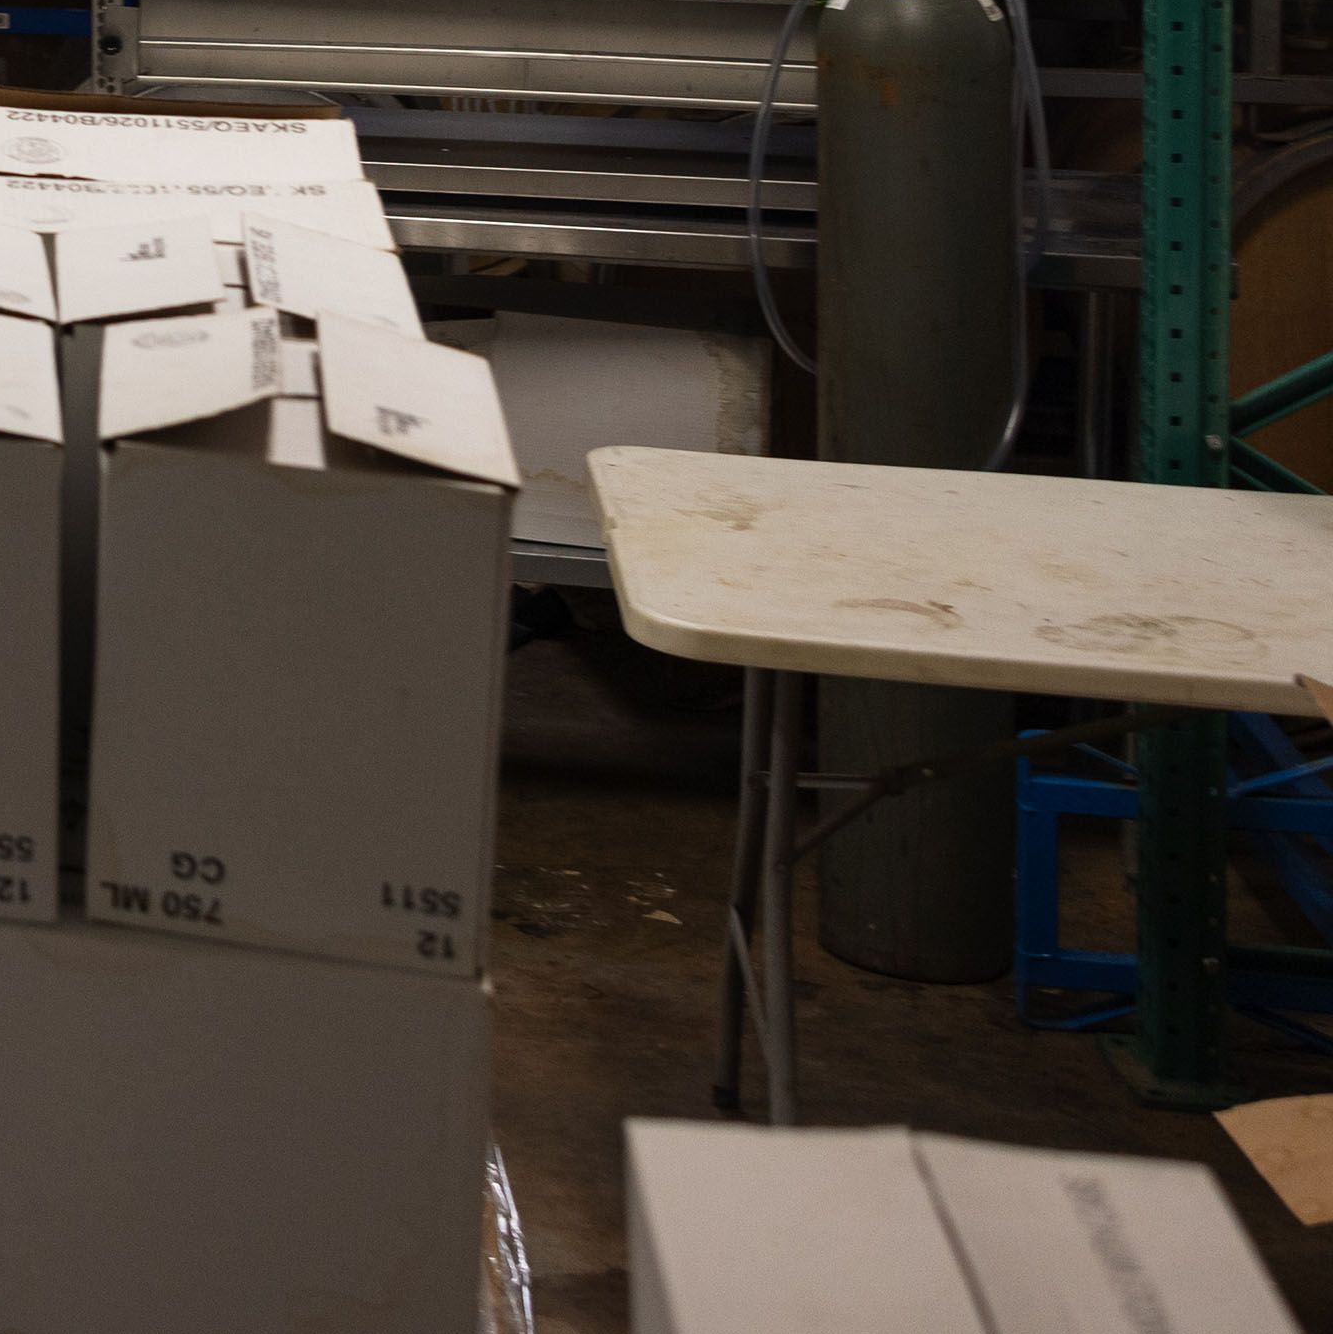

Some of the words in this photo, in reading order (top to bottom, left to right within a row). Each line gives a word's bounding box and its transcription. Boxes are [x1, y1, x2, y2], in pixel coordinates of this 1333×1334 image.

[170, 850, 226, 884] CG
[99, 880, 151, 915] ML
[160, 891, 224, 928] 750
[416, 931, 456, 961] 12
